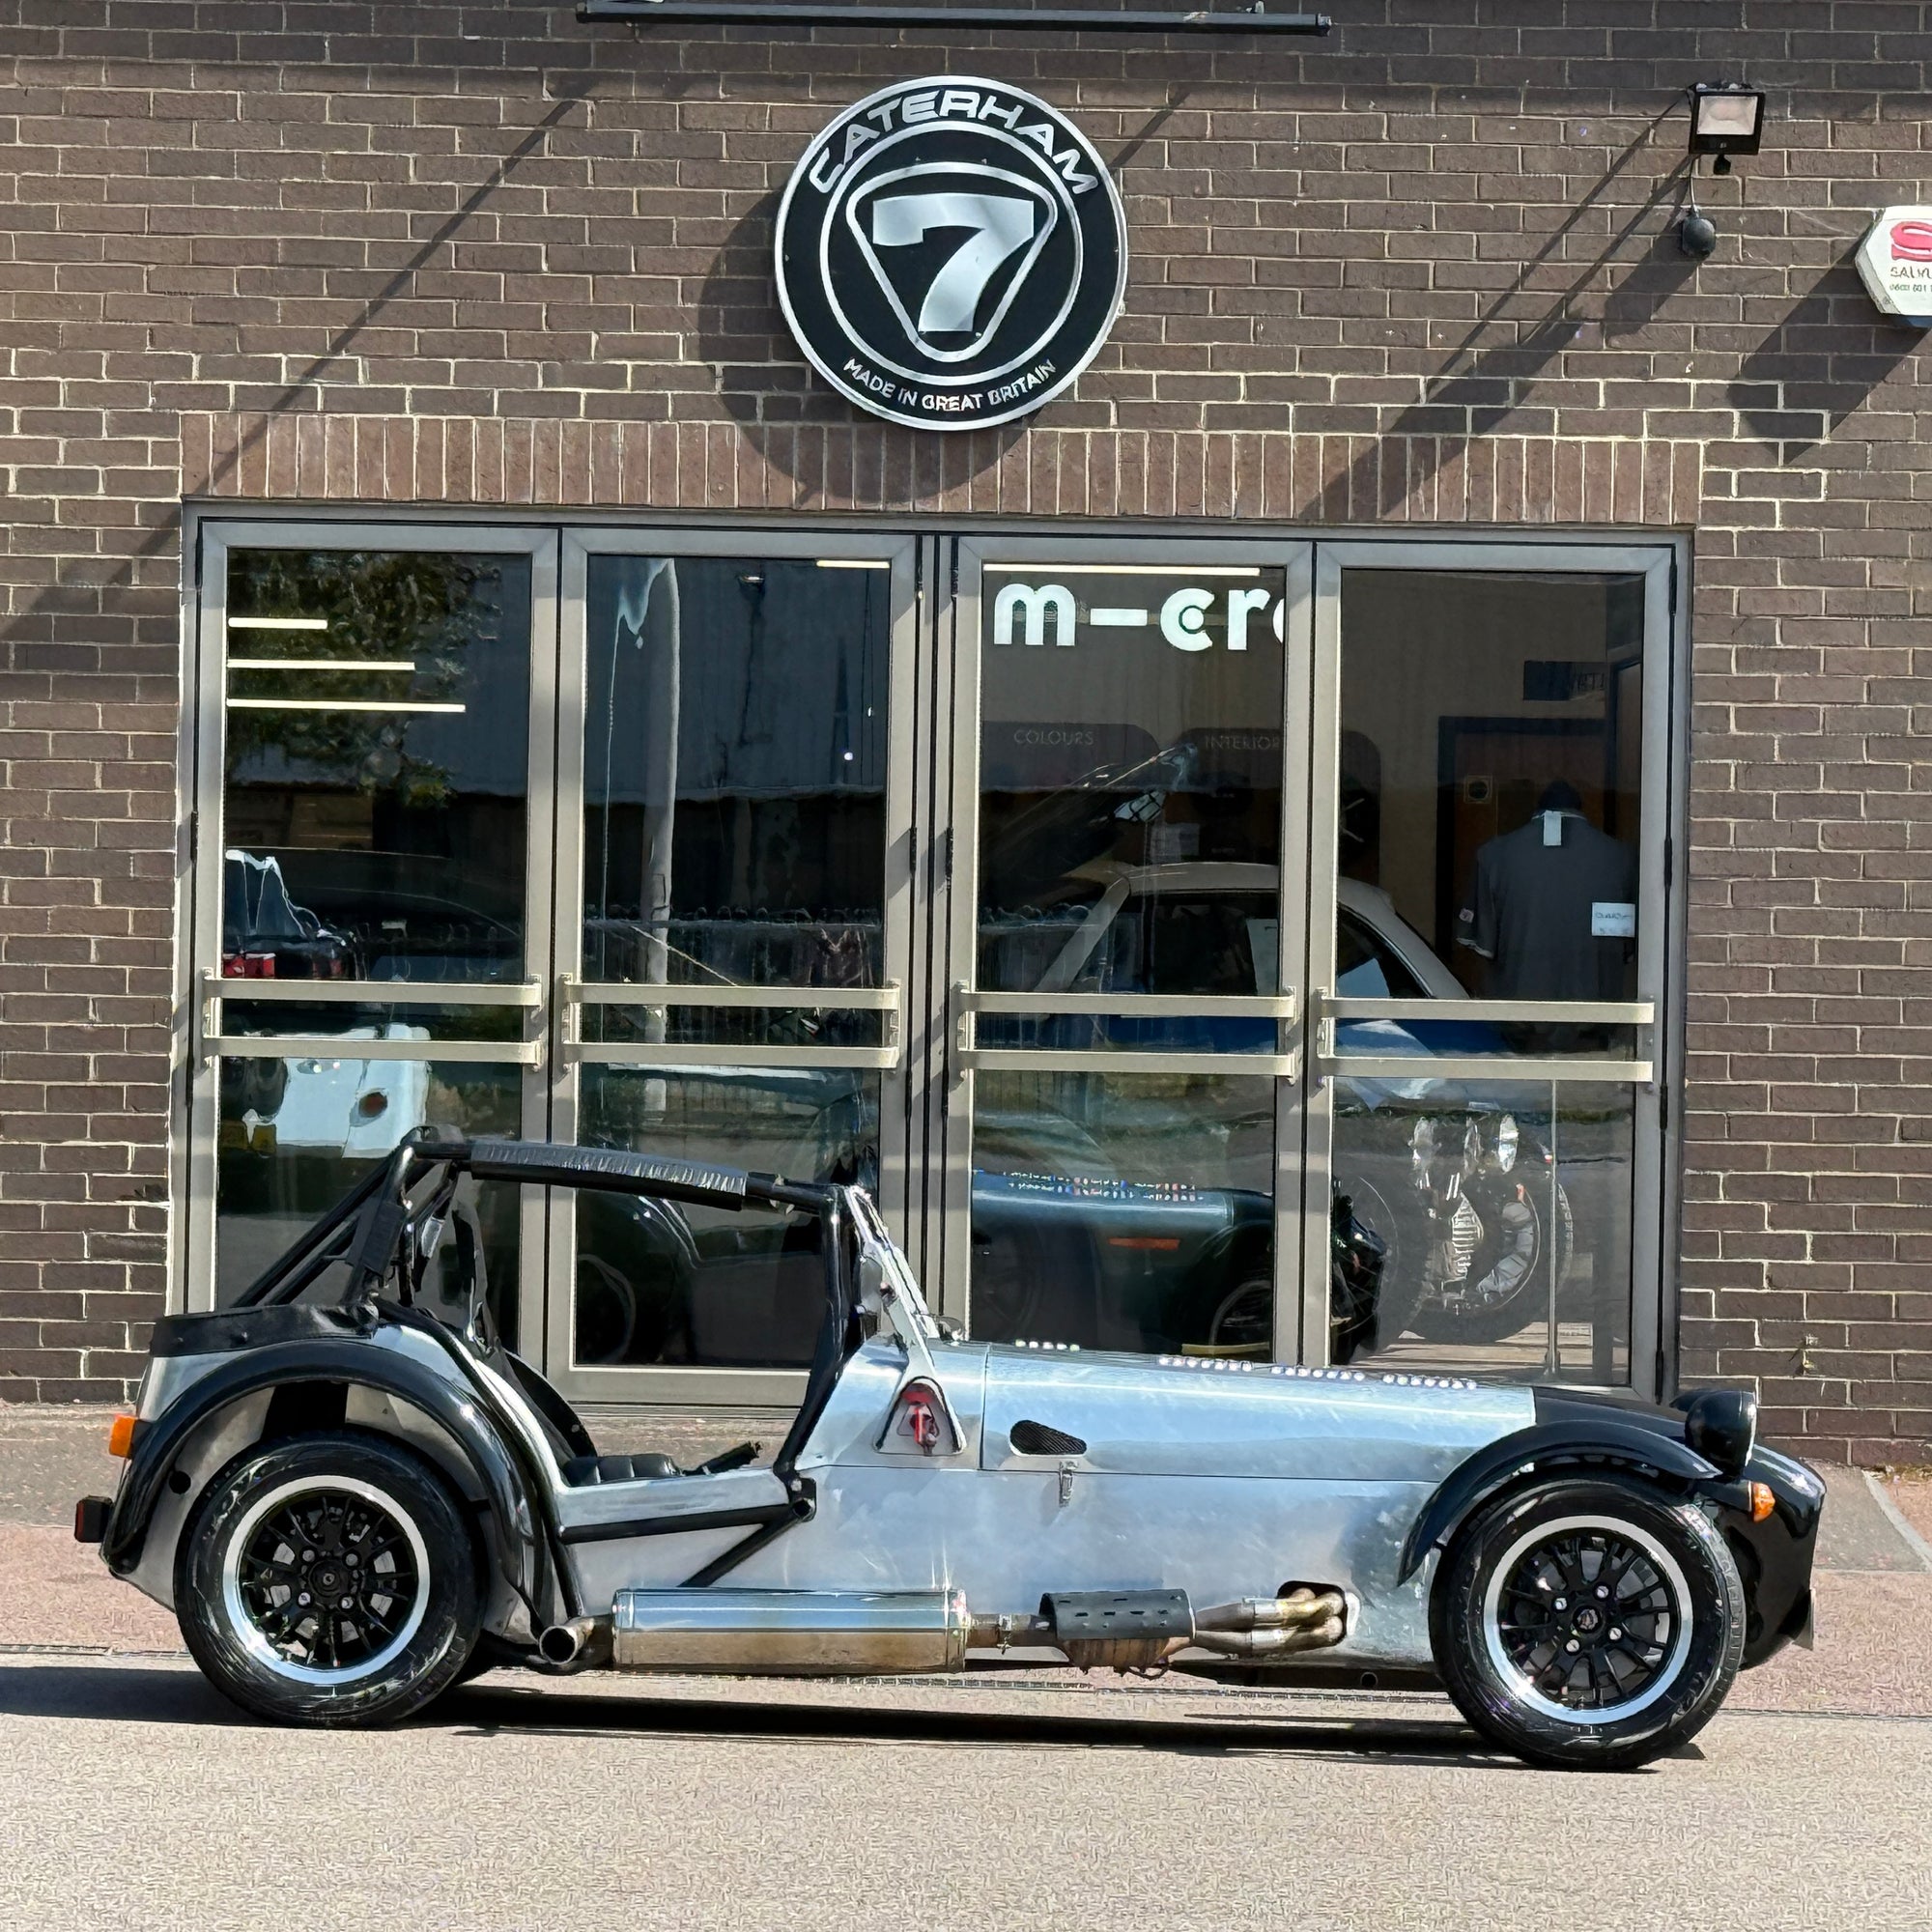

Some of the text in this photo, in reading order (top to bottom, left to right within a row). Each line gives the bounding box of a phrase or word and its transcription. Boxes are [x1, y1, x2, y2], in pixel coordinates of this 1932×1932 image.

[810, 90, 1098, 193] CATERHAM
[872, 192, 1035, 332] 7
[843, 357, 1057, 412] MADE IN GREAT BRITAIN
[1014, 728, 1094, 746] COLOURS
